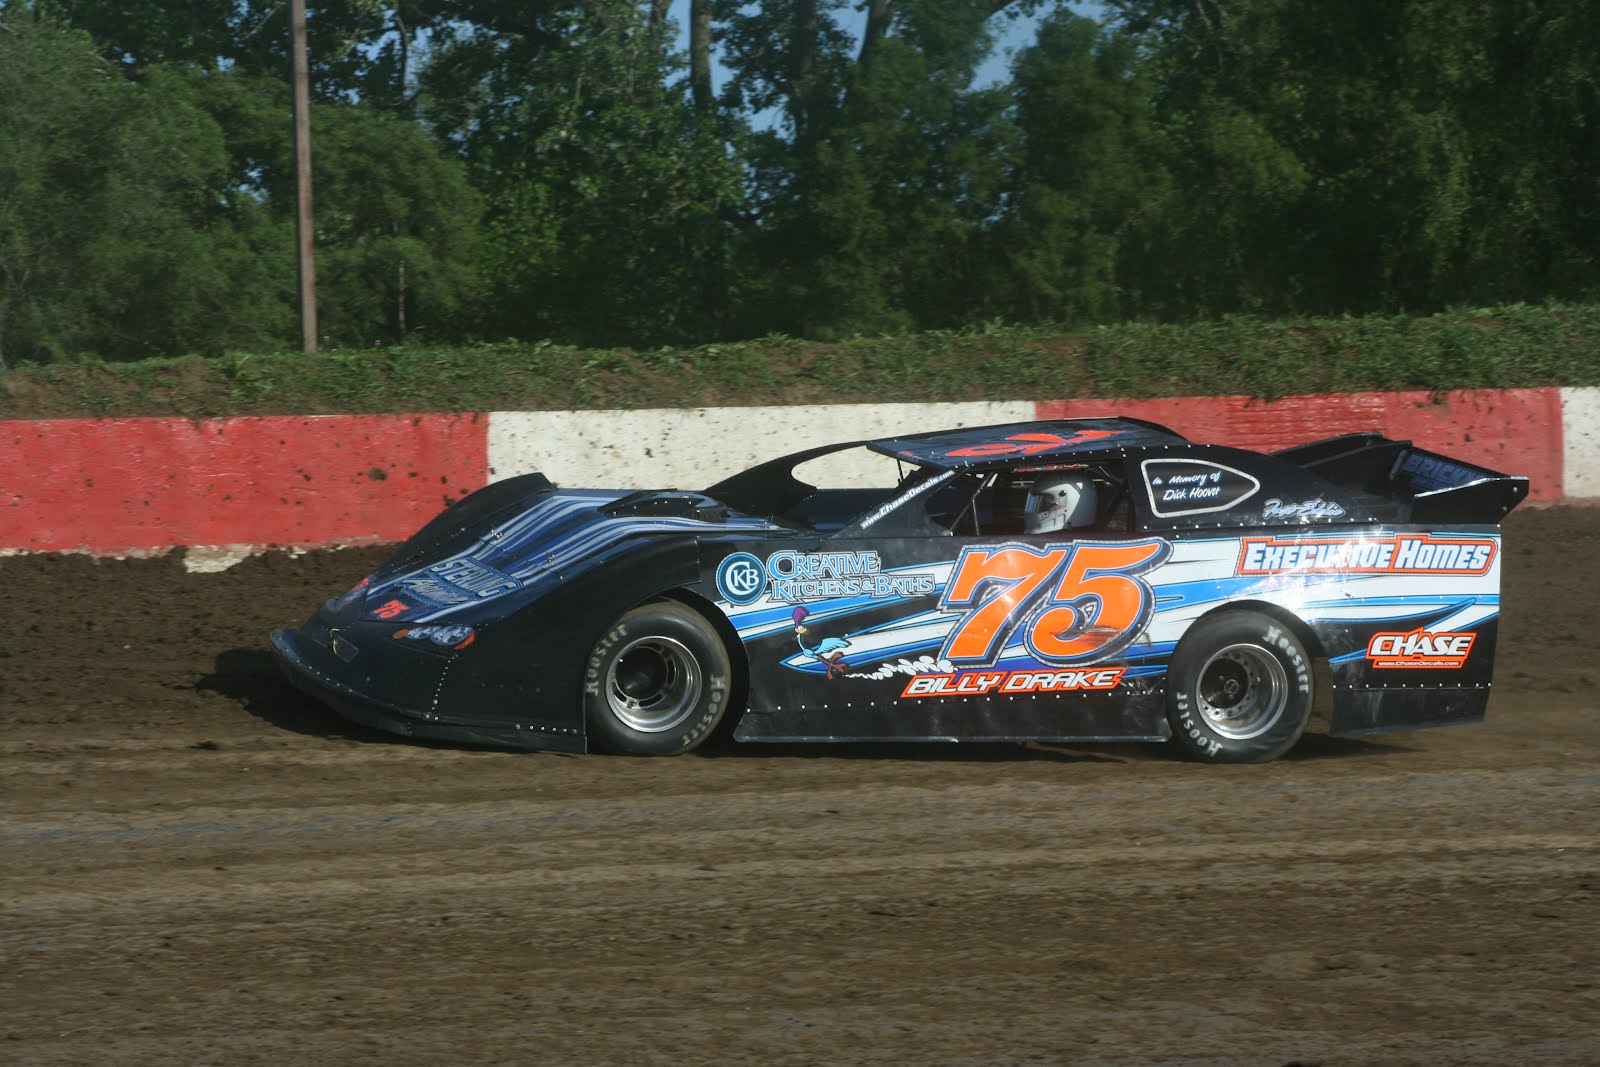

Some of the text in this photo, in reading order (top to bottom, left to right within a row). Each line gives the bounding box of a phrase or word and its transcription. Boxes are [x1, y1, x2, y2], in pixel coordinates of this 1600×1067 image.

[1168, 474, 1207, 486] Memory
[1209, 471, 1221, 482] of
[1163, 486, 1220, 501] Dick Hoover
[768, 552, 880, 580] CREATIVE
[773, 579, 861, 600] KITCHENS
[873, 575, 933, 596] BATHS
[372, 599, 410, 619] 75
[942, 538, 1169, 662] 75
[1370, 633, 1472, 656] CHASE
[906, 669, 1121, 695] BILLY DRAKE
